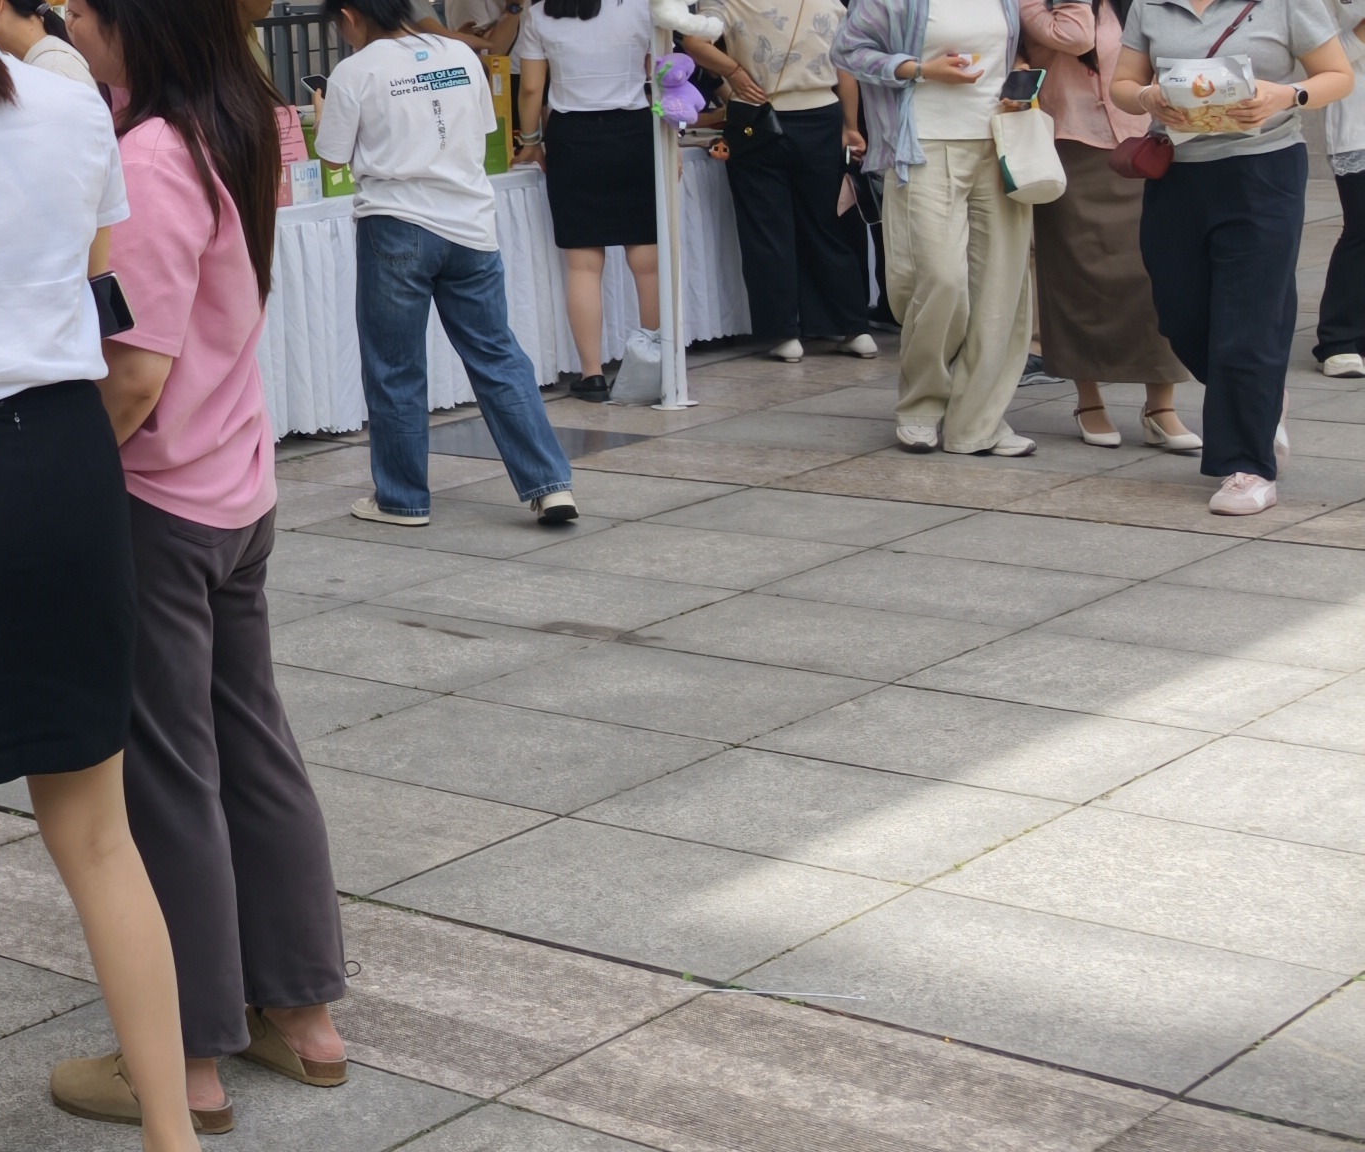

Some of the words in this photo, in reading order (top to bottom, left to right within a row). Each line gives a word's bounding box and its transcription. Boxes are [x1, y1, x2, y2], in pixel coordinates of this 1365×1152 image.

[389, 76, 416, 88] Living
[418, 73, 435, 82] Full
[436, 71, 447, 79] Of
[447, 68, 465, 77] Love
[390, 87, 411, 97] Care
[412, 84, 429, 93] And
[431, 77, 470, 90] Kindness
[293, 163, 318, 182] Lumi
